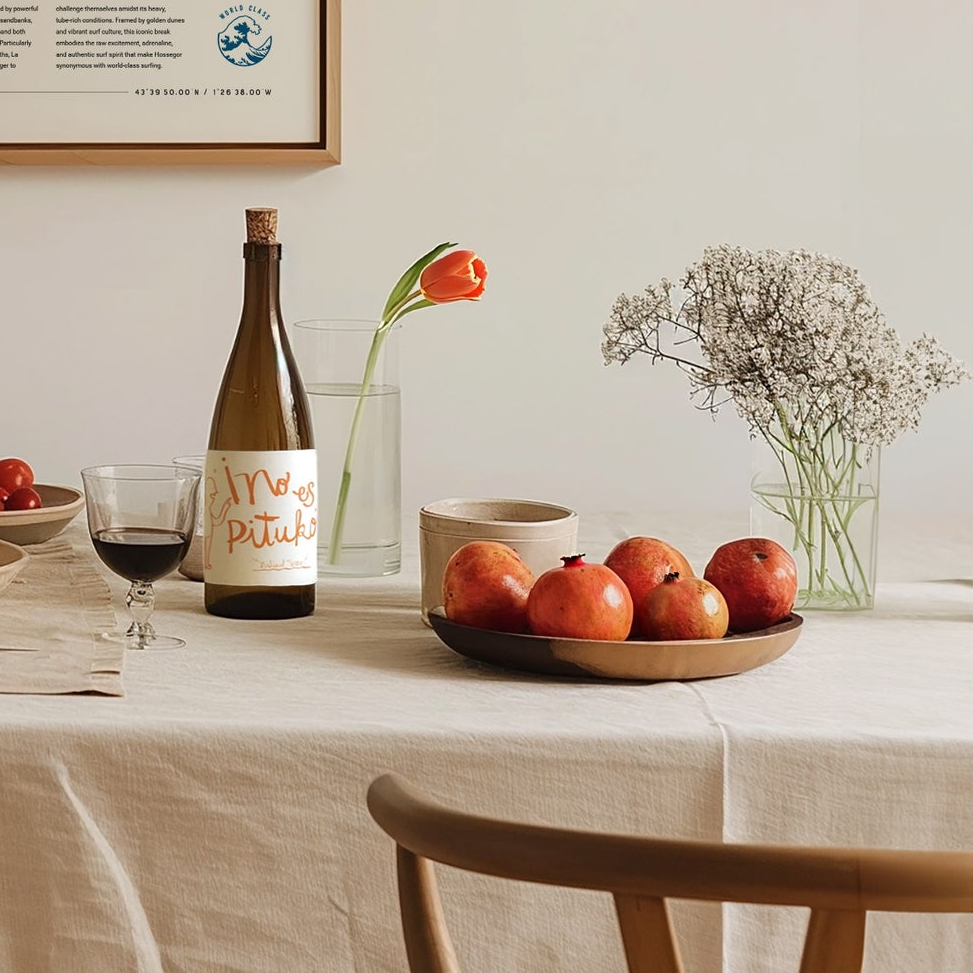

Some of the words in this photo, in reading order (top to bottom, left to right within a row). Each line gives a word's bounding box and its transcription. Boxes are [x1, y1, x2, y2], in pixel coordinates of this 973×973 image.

[5, 6, 12, 14] by
[13, 6, 39, 14] powerful
[56, 6, 83, 14] challenge
[148, 6, 166, 14] heavy,
[218, 4, 244, 20] WORLD
[248, 5, 271, 21] CLASS
[0, 17, 33, 25] sandbanks,
[138, 17, 145, 25] by
[146, 17, 166, 25] golden
[101, 28, 123, 36] culture,
[108, 51, 124, 59] spirit
[154, 51, 183, 59] Hossegor
[141, 62, 163, 70] surfing.
